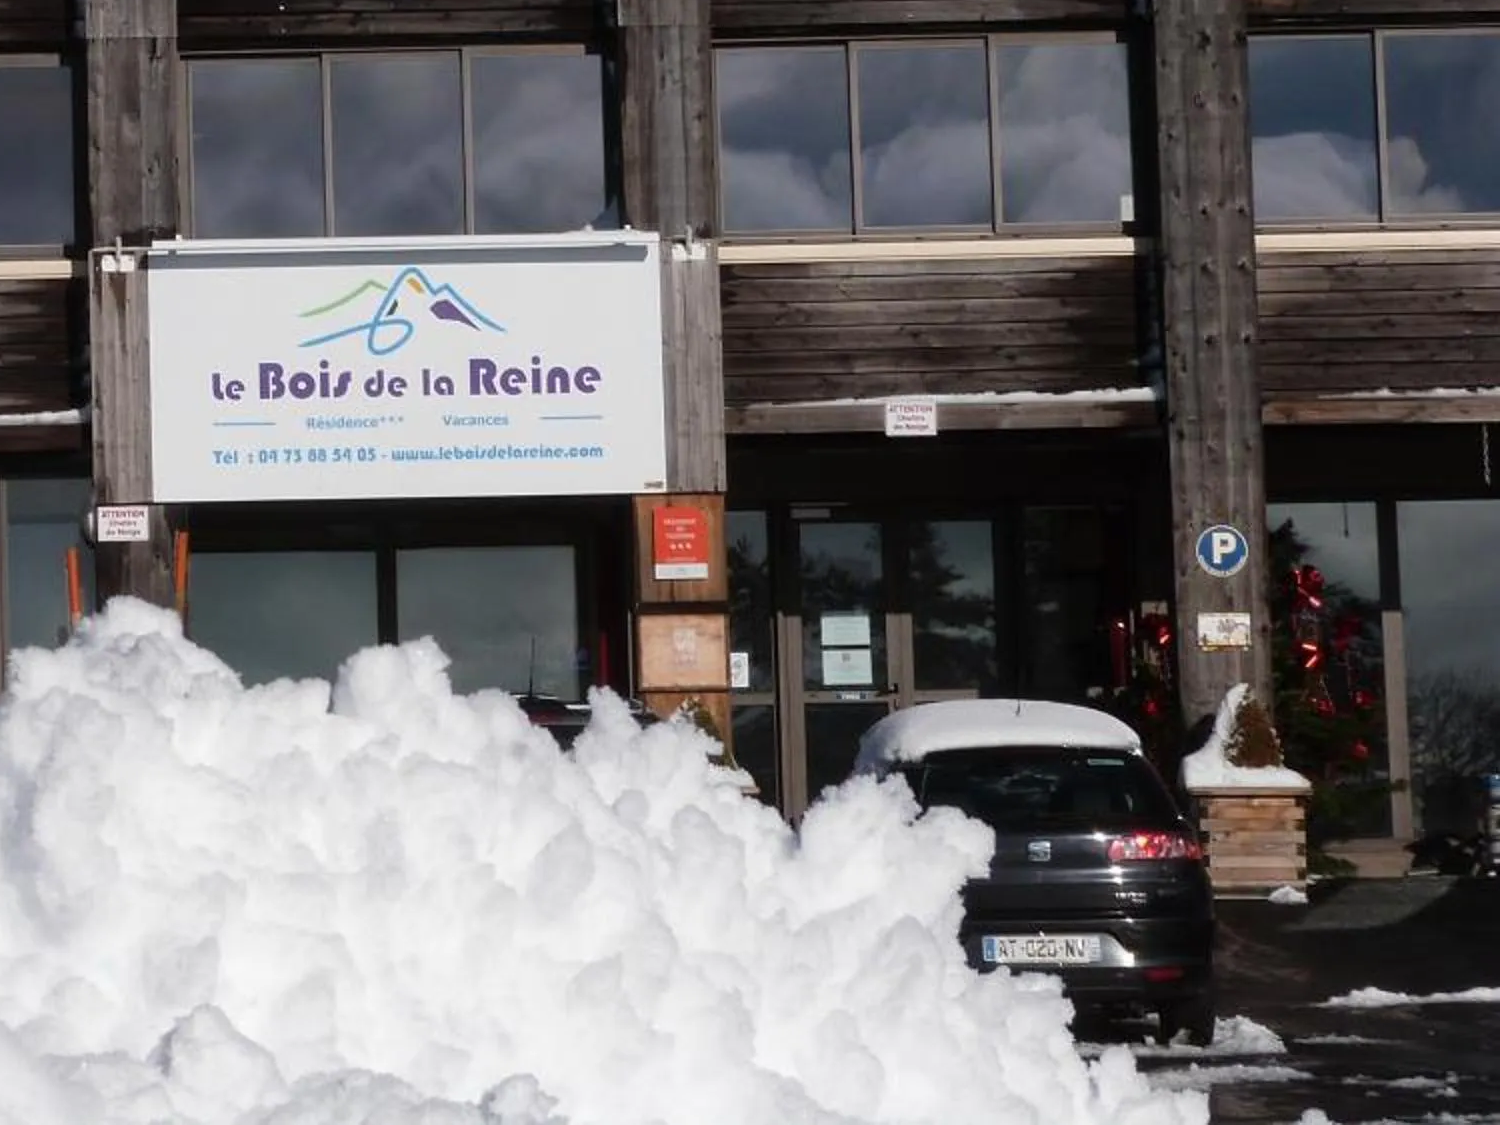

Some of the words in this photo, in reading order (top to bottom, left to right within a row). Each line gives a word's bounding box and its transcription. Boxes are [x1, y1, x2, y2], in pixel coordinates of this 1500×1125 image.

[258, 360, 352, 399] Bois
[363, 369, 408, 398] de
[422, 368, 455, 396] la
[468, 355, 602, 396] Reine
[442, 413, 509, 427] Vacances
[284, 448, 302, 463] 73
[307, 448, 327, 463] 88
[357, 446, 377, 462] 05
[390, 443, 604, 462] www.leboisdelareine.com
[101, 510, 145, 518] ATTENTION
[1211, 532, 1237, 564] P
